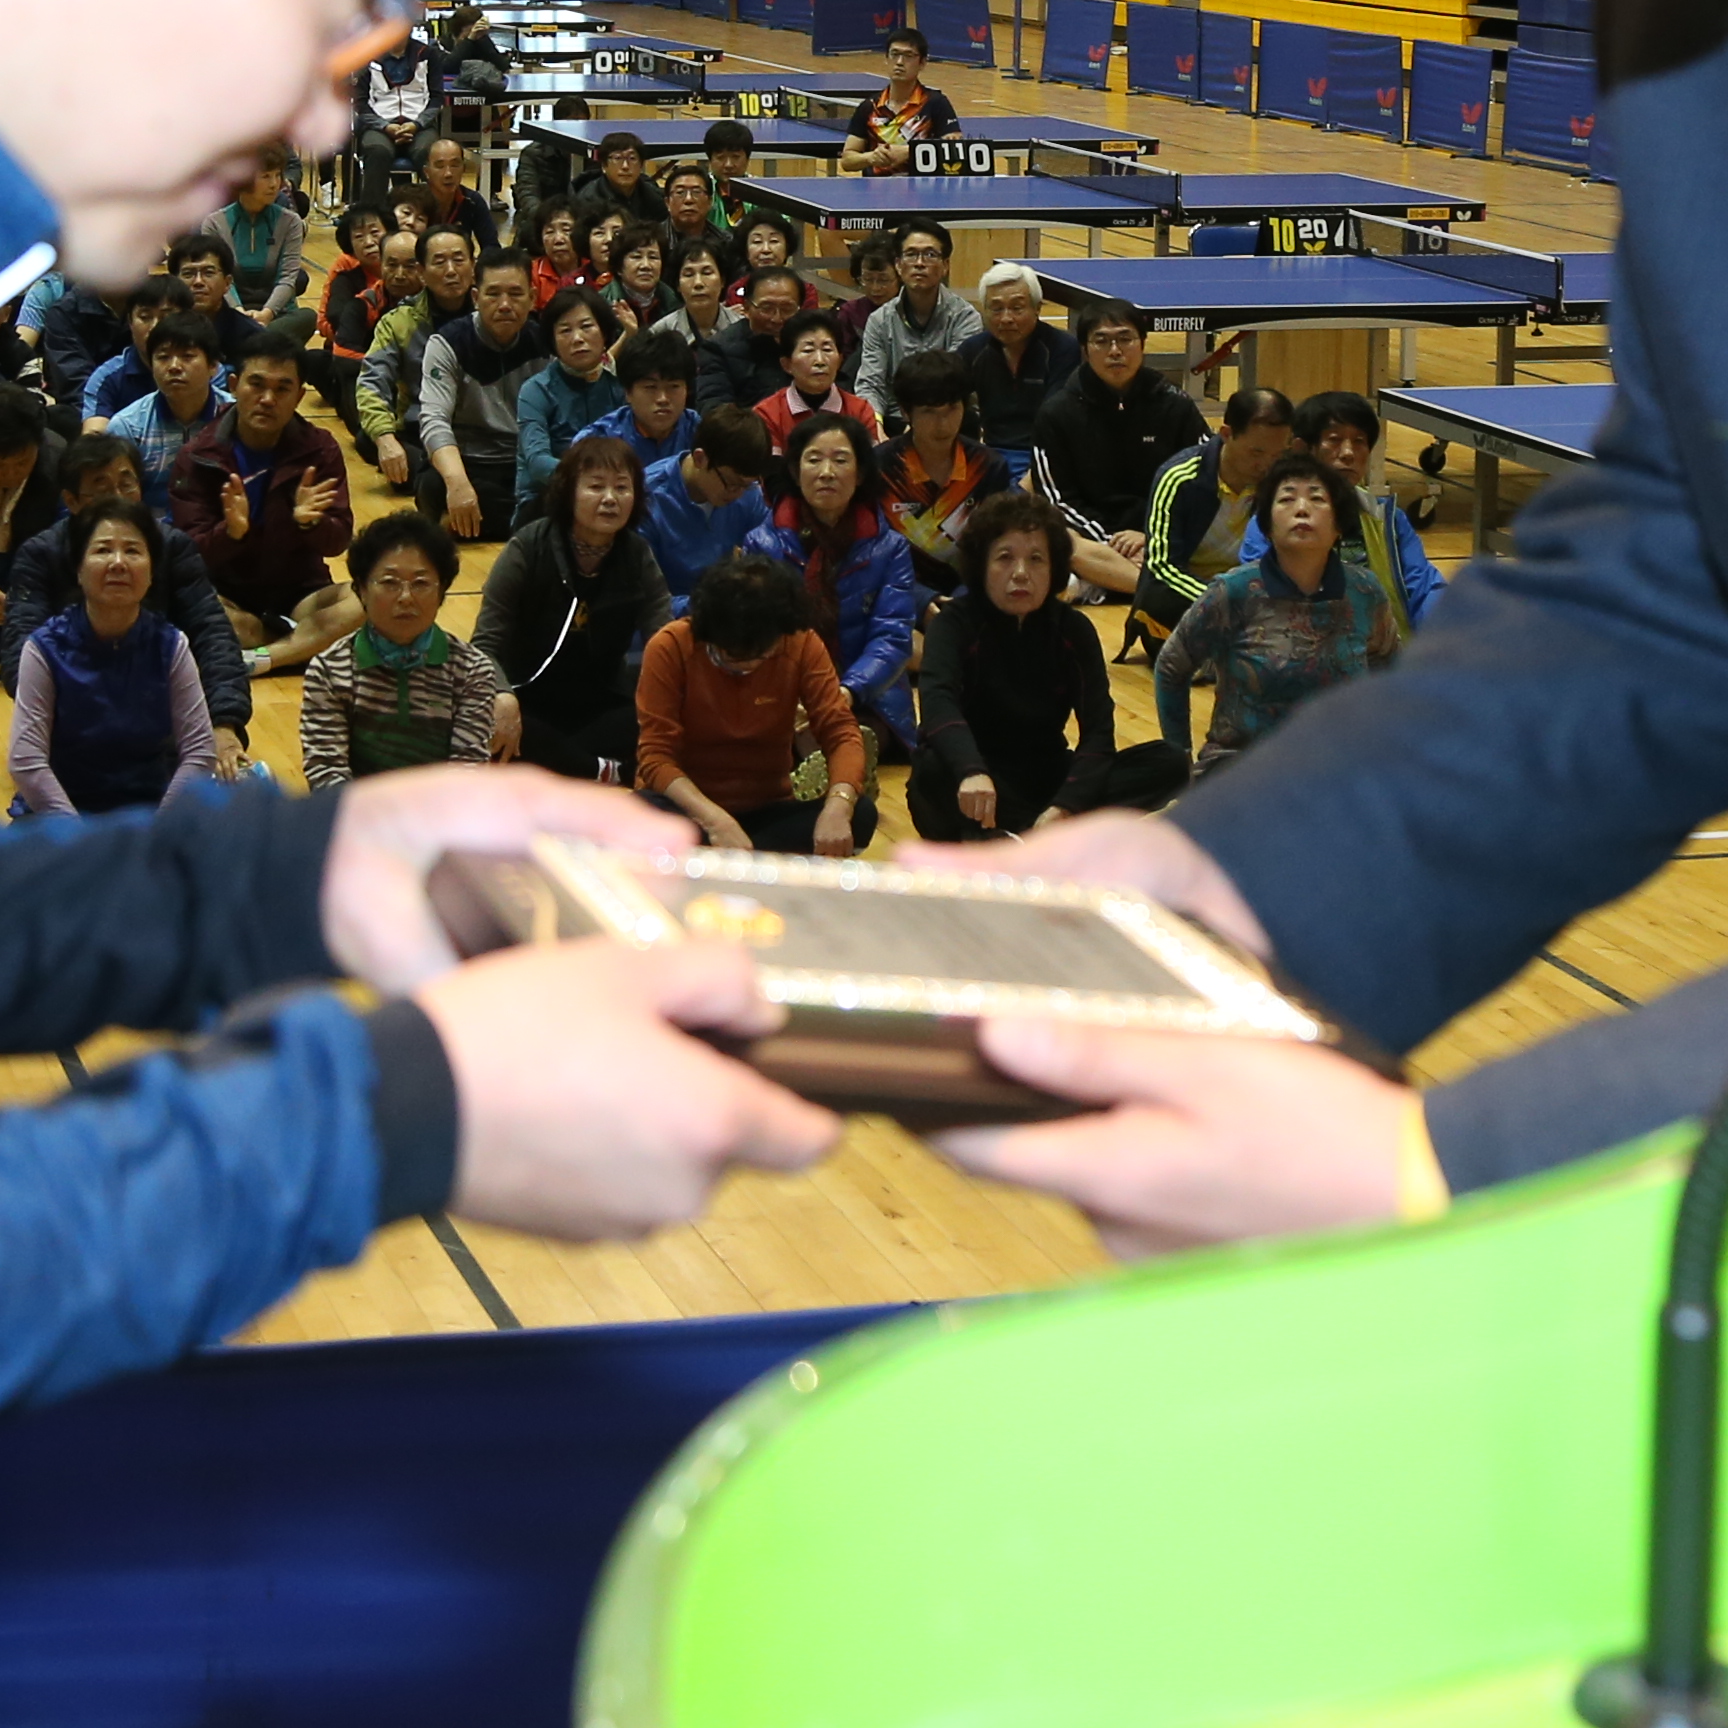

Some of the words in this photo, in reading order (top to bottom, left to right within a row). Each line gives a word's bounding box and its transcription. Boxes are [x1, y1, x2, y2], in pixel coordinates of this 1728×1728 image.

[453, 96, 486, 106] BUTTERFLY
[840, 217, 885, 229] BUTTERFLY
[1268, 217, 1296, 253] 10
[1153, 317, 1206, 331] BUTTERFLY
